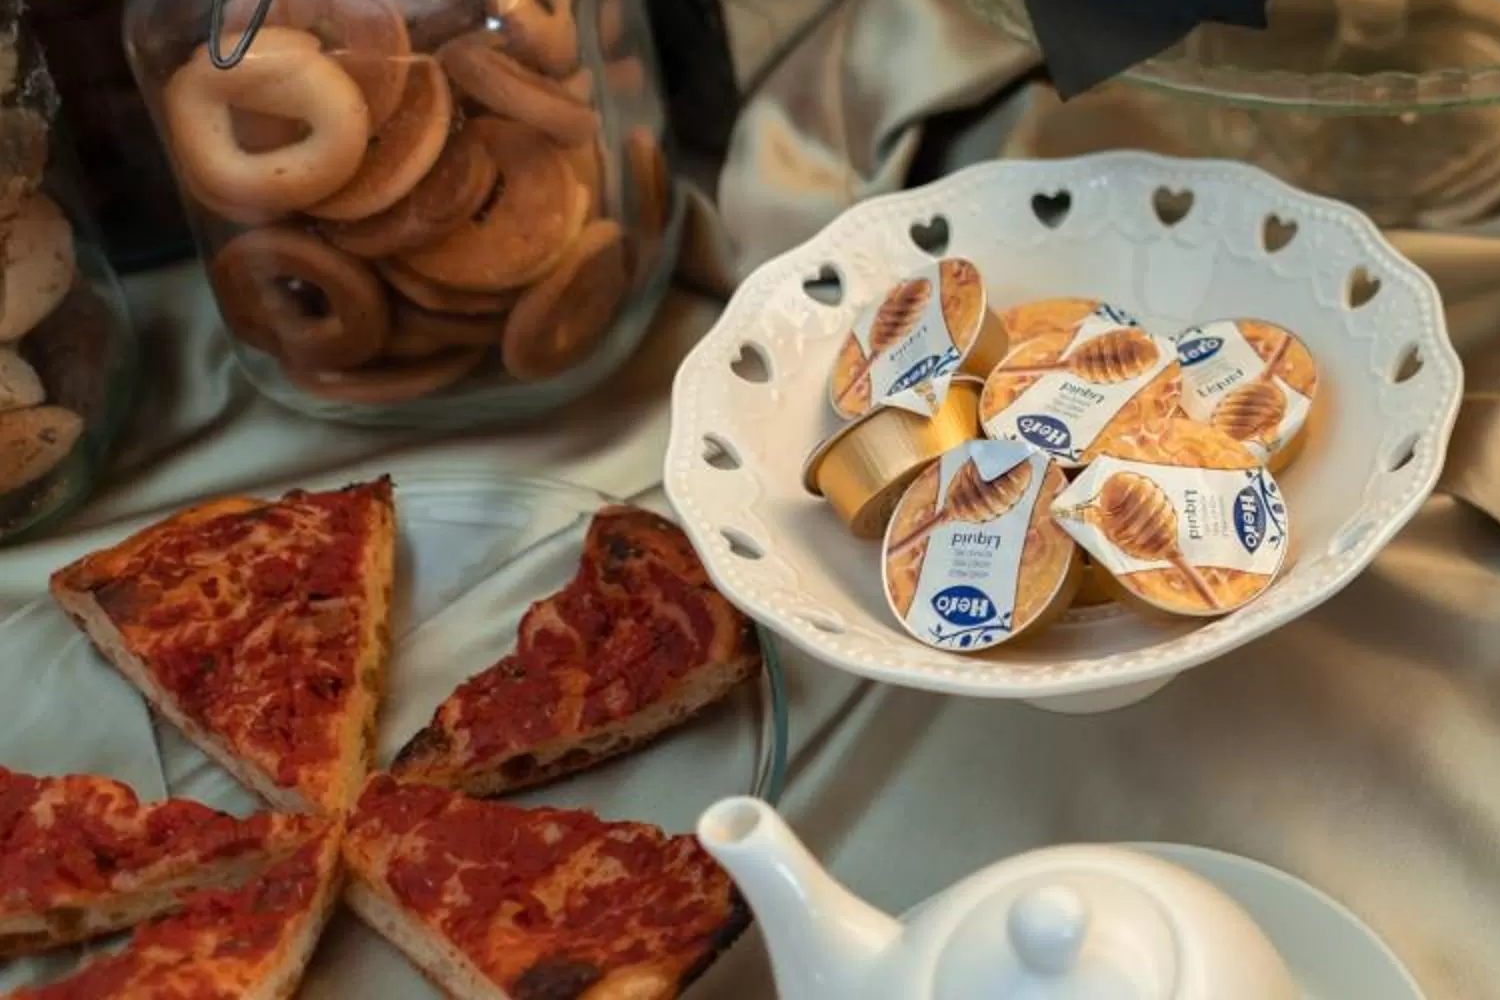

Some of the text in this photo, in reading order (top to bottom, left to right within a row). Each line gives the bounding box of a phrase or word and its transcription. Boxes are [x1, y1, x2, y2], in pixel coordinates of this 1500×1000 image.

[1063, 381, 1105, 405] Liquid
[1020, 416, 1069, 449] Hero
[1184, 488, 1199, 541] Liquid
[1239, 495, 1260, 549] Hero
[951, 529, 1001, 550] Liquid
[935, 590, 990, 615] Hero
